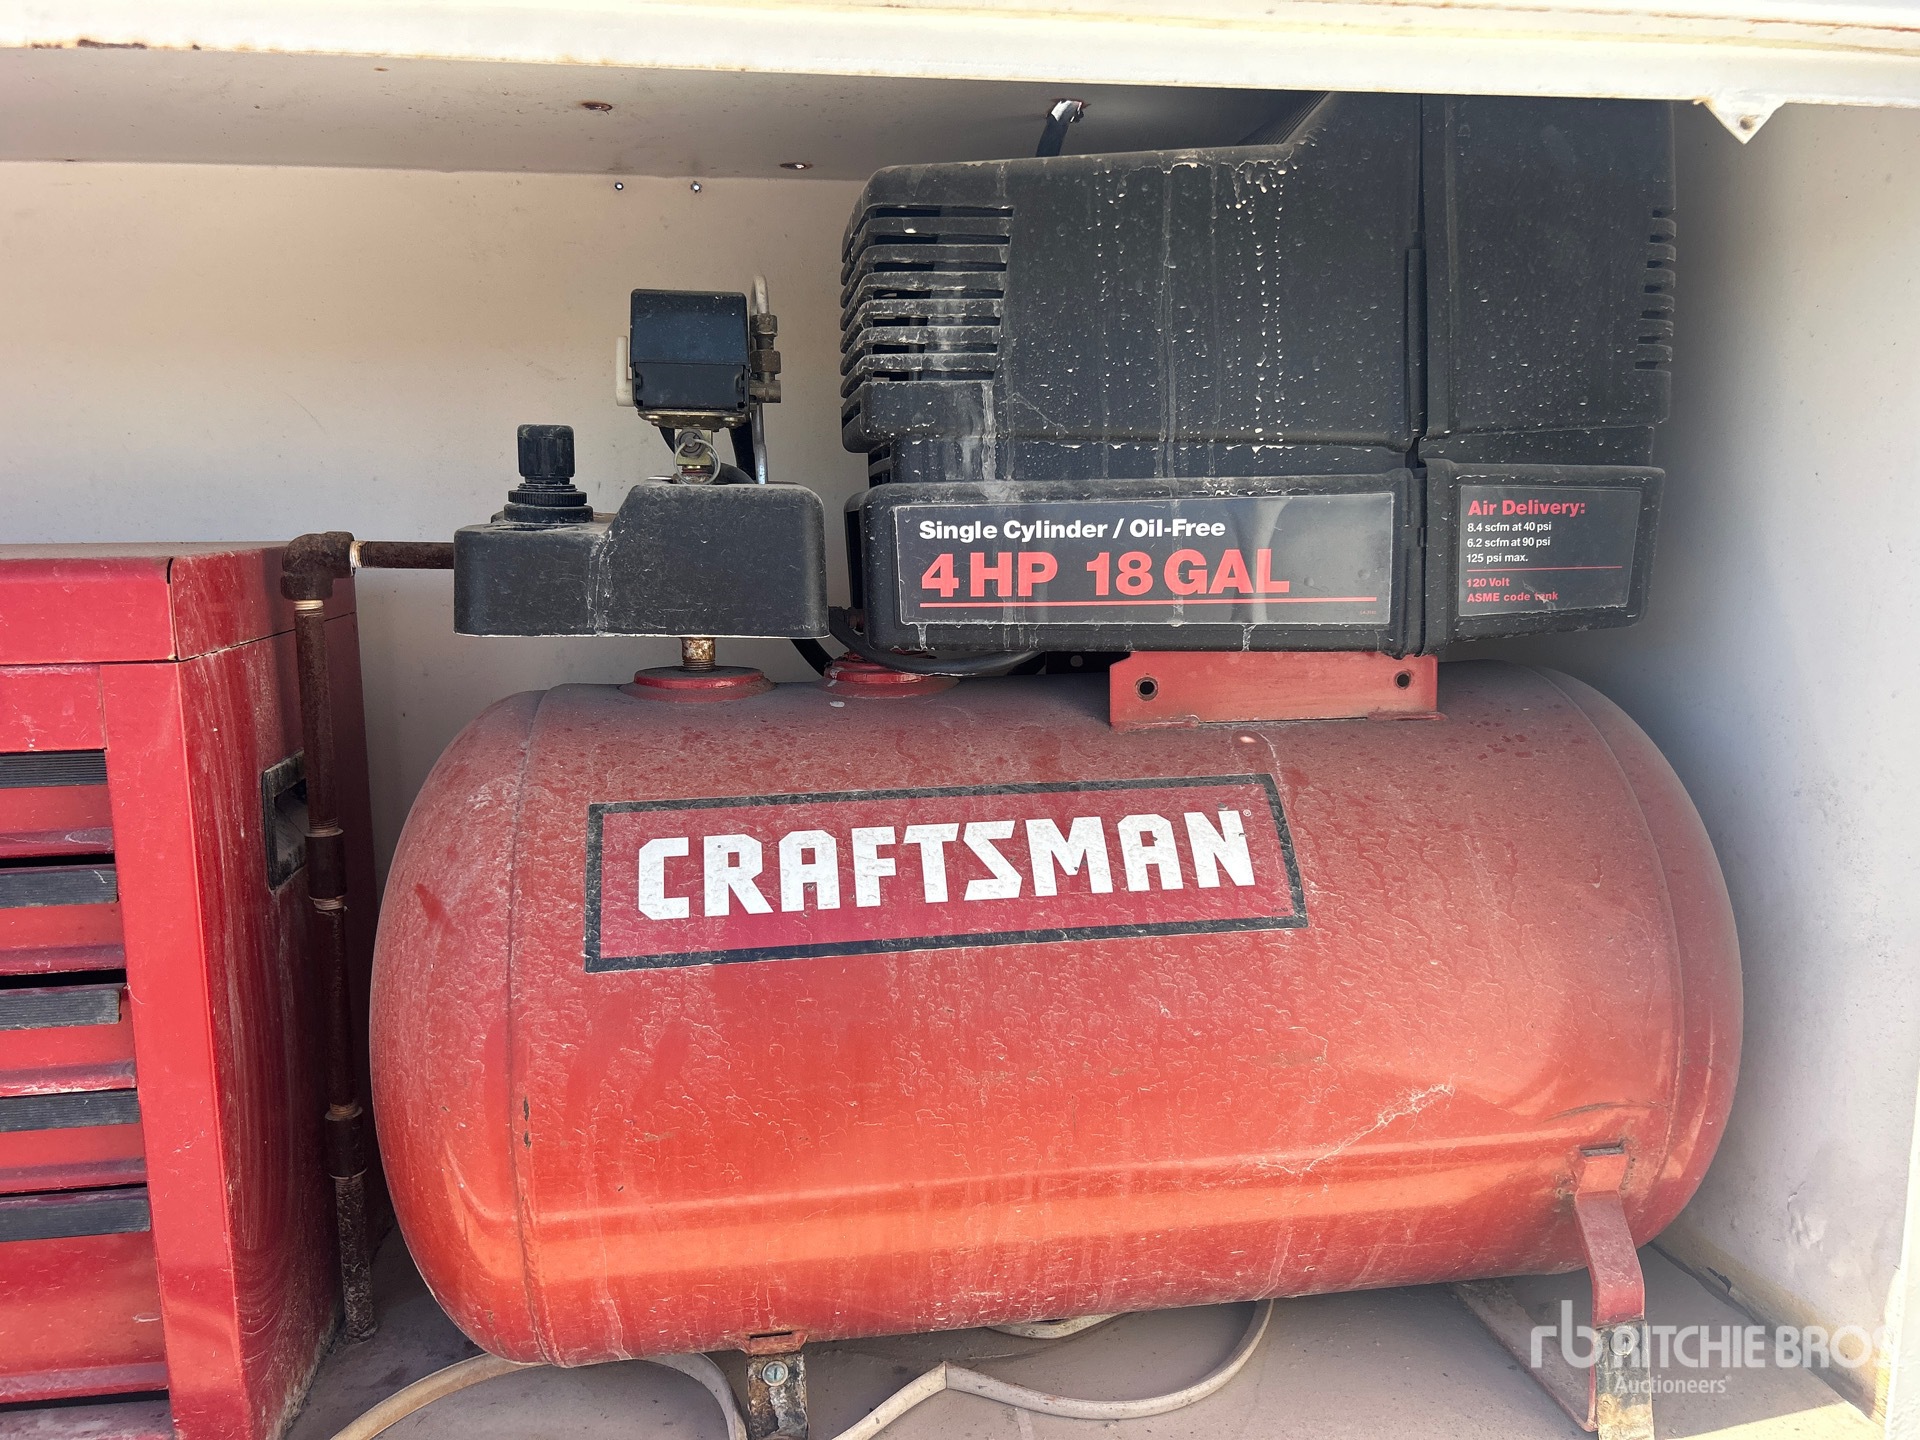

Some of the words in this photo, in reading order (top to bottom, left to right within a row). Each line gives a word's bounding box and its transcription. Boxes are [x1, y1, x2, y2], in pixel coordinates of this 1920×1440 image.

[1468, 500, 1497, 515] Air
[1502, 499, 1585, 517] Delivery:
[919, 520, 998, 543] Single
[1003, 520, 1108, 543] Cylinder
[1112, 518, 1125, 539] /
[1129, 518, 1226, 537] Oil-Free
[1467, 522, 1483, 532] 8.4
[1484, 522, 1510, 532] scfm
[1511, 522, 1522, 532] at
[1523, 521, 1536, 531] 40
[1537, 521, 1552, 533] psi
[1467, 538, 1483, 548] 6.2
[1484, 538, 1510, 547] scfm
[1510, 538, 1521, 547] at
[1522, 537, 1535, 547] 90
[1535, 536, 1551, 548] psi
[1466, 553, 1484, 563] 125
[1486, 553, 1502, 564] psi
[1504, 554, 1529, 562] max.
[921, 553, 960, 598] 4
[970, 551, 1058, 597] HP
[1086, 551, 1153, 596] 18
[1163, 548, 1290, 595] GAL
[1467, 578, 1487, 588] 120
[1489, 577, 1510, 587] Volt
[1467, 592, 1500, 603] ASME
[1503, 592, 1531, 602] code
[1534, 591, 1559, 601] tank
[637, 809, 1256, 920] CRAFTSMAN
